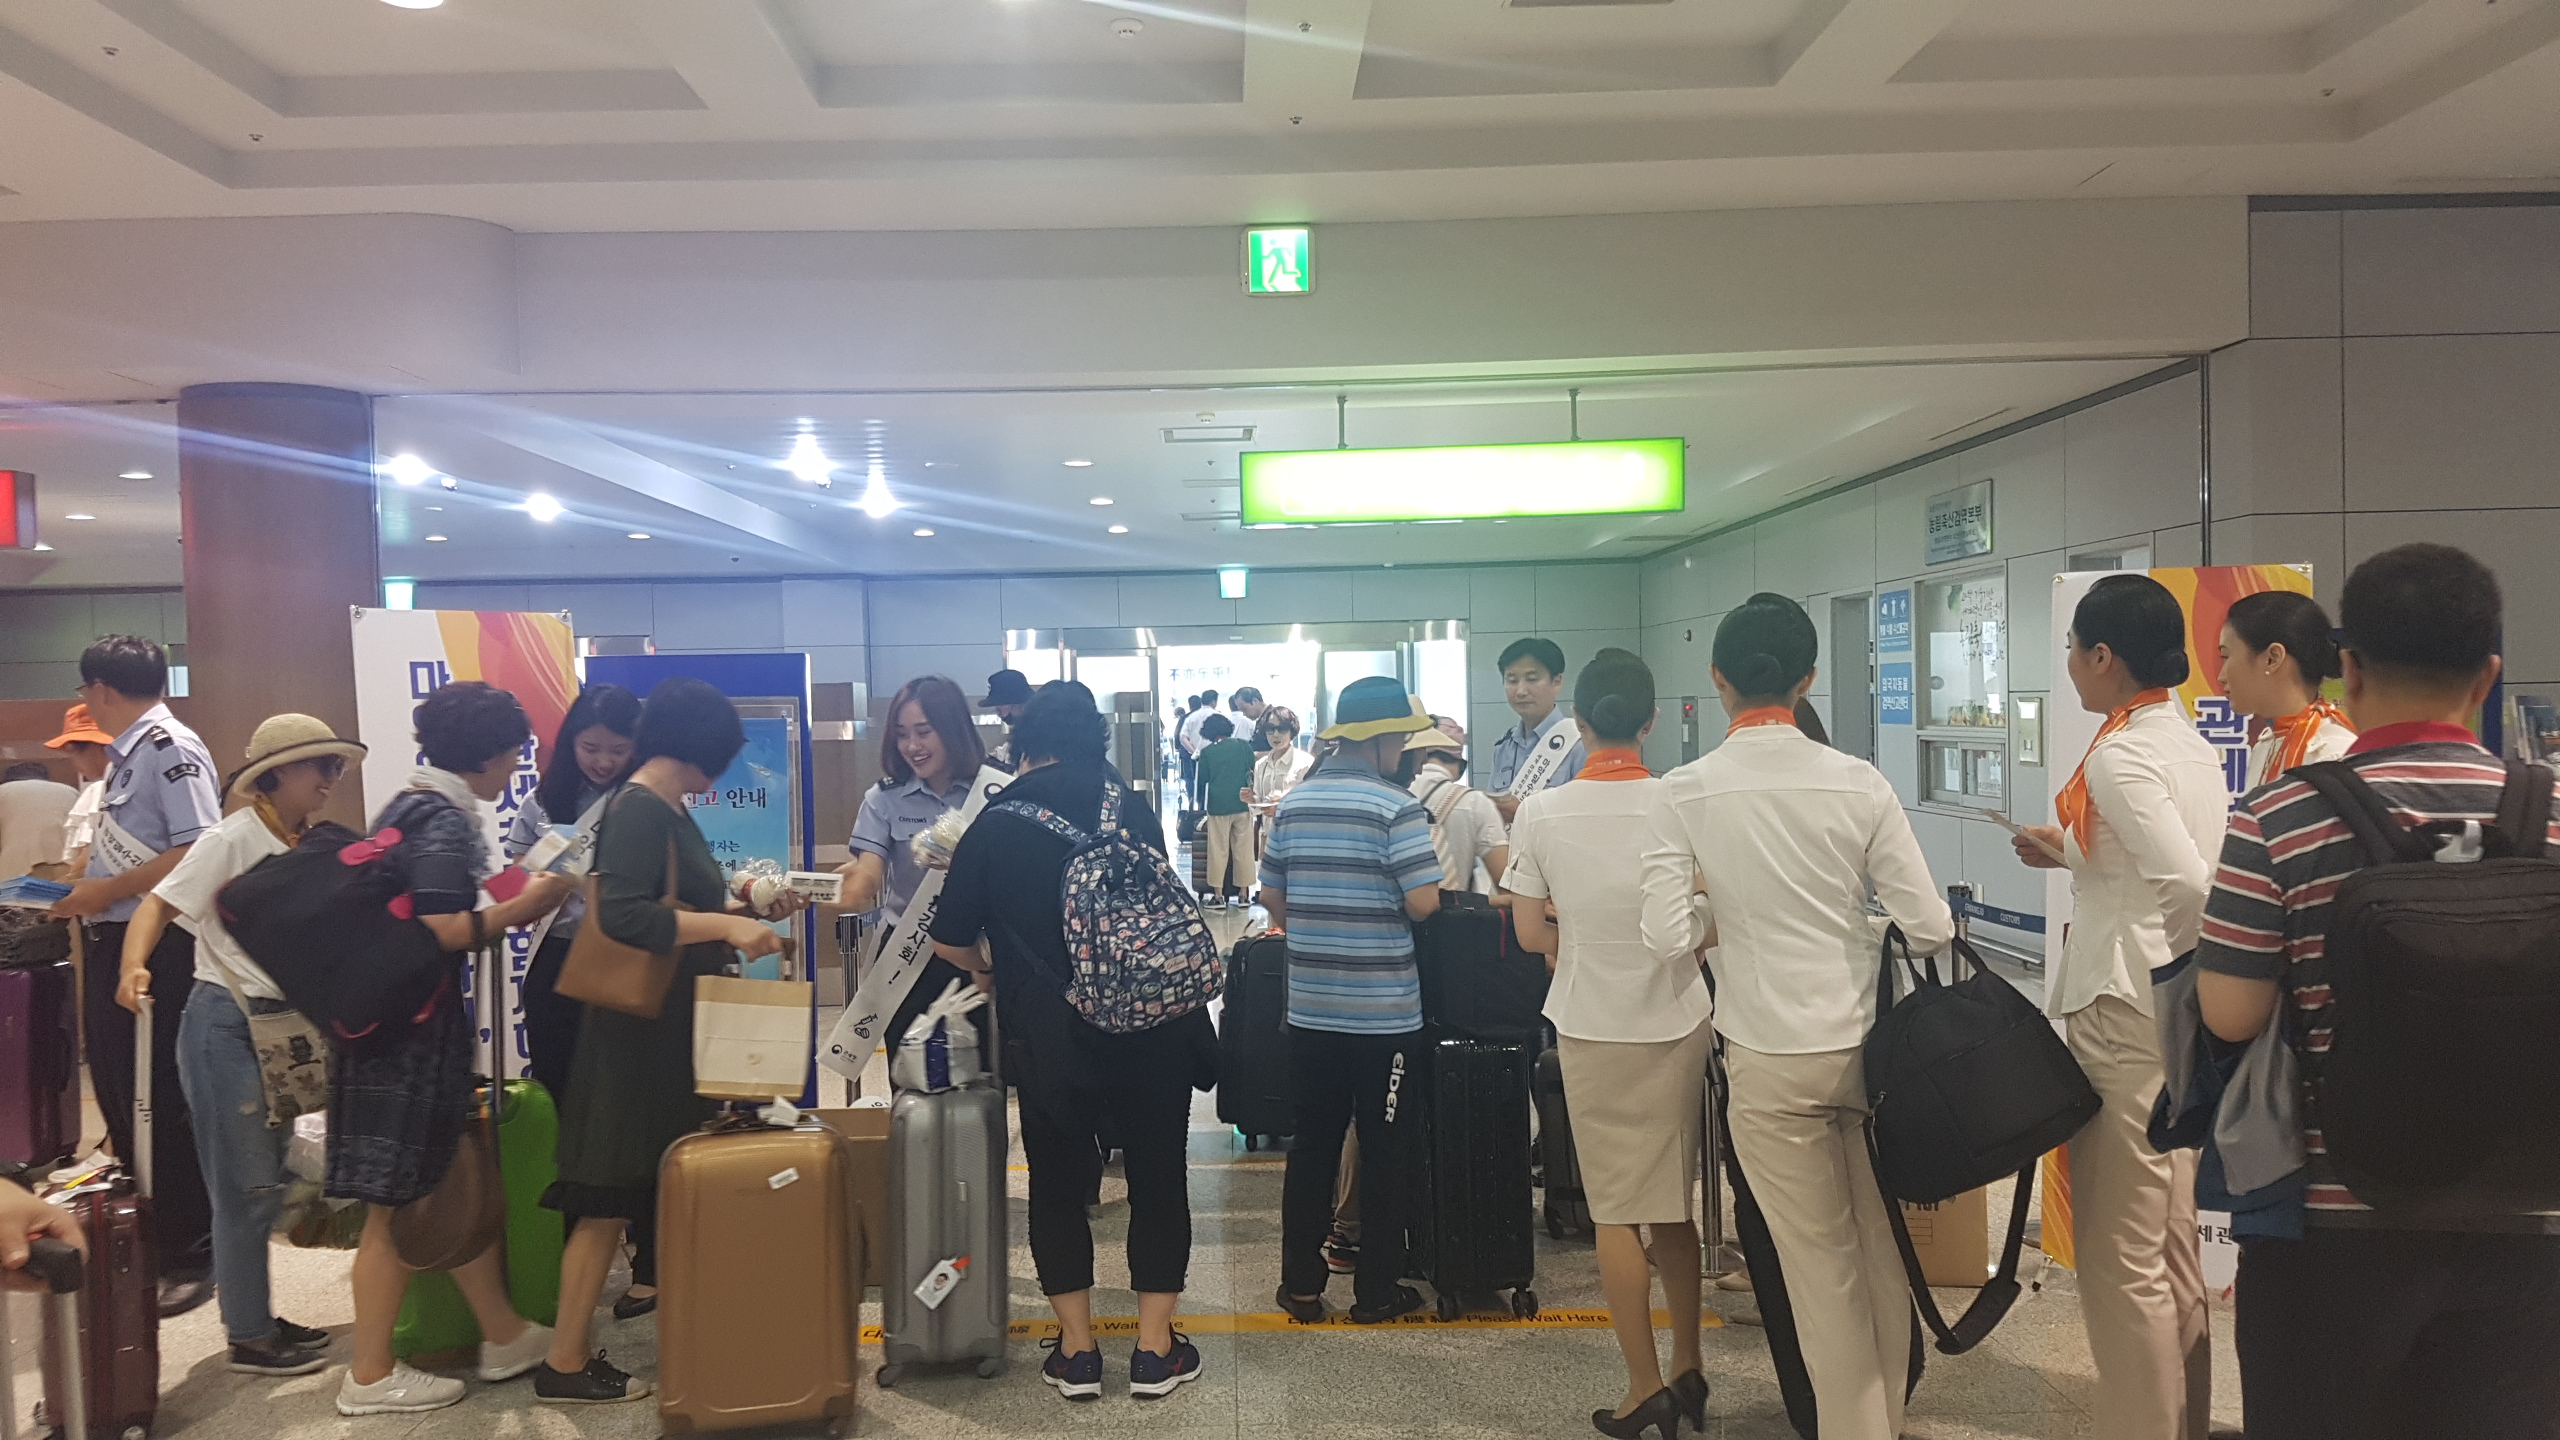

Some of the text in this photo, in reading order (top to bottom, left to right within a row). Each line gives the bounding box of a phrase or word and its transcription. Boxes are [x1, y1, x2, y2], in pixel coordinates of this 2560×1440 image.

[726, 787, 766, 809] 안내
[898, 816, 927, 824] CUSTOMS
[1999, 913, 2021, 925] CUSTOMS
[1526, 1313, 1563, 1323] Wait
[1567, 1313, 1608, 1323] Here
[1104, 1321, 1139, 1330] Wait
